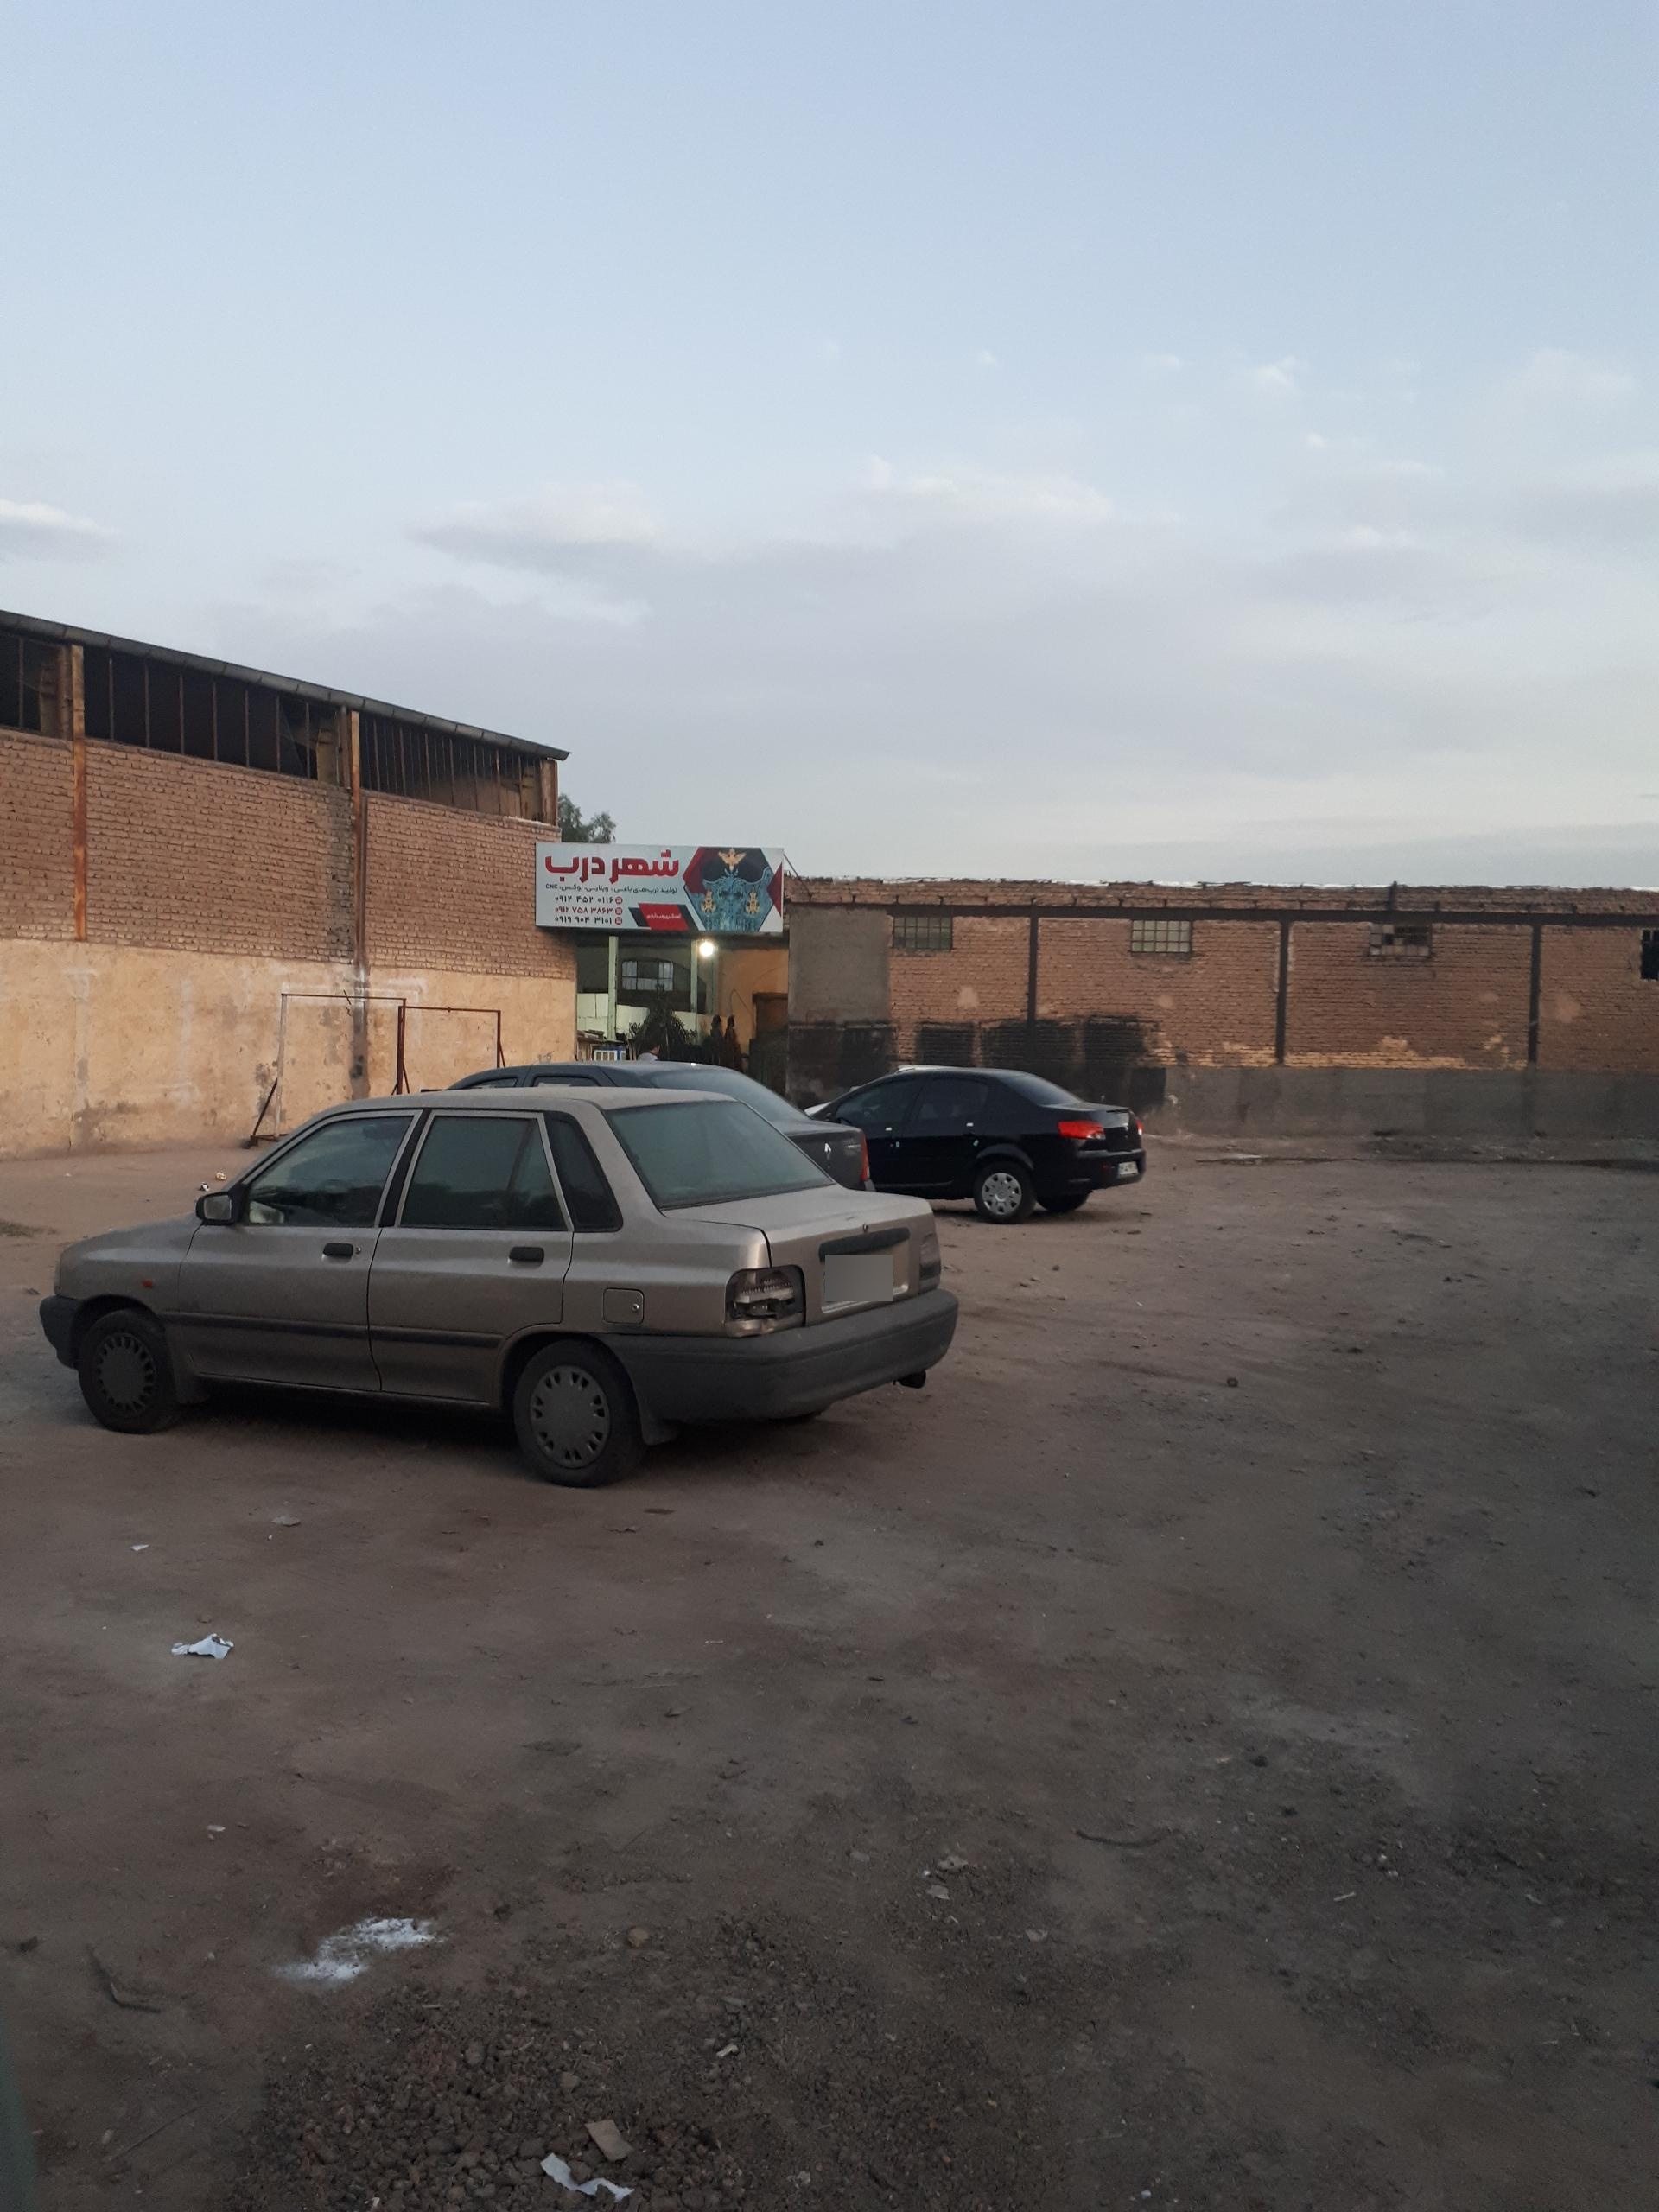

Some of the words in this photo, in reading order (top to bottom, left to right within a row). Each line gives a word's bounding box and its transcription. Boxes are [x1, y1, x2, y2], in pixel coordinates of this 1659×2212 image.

[544, 856, 606, 883] درب
[609, 849, 679, 884] شهر
[576, 895, 594, 904] ۴۵۲
[555, 906, 570, 914] ۰۹۱۲
[572, 906, 588, 915] ۷۵۸
